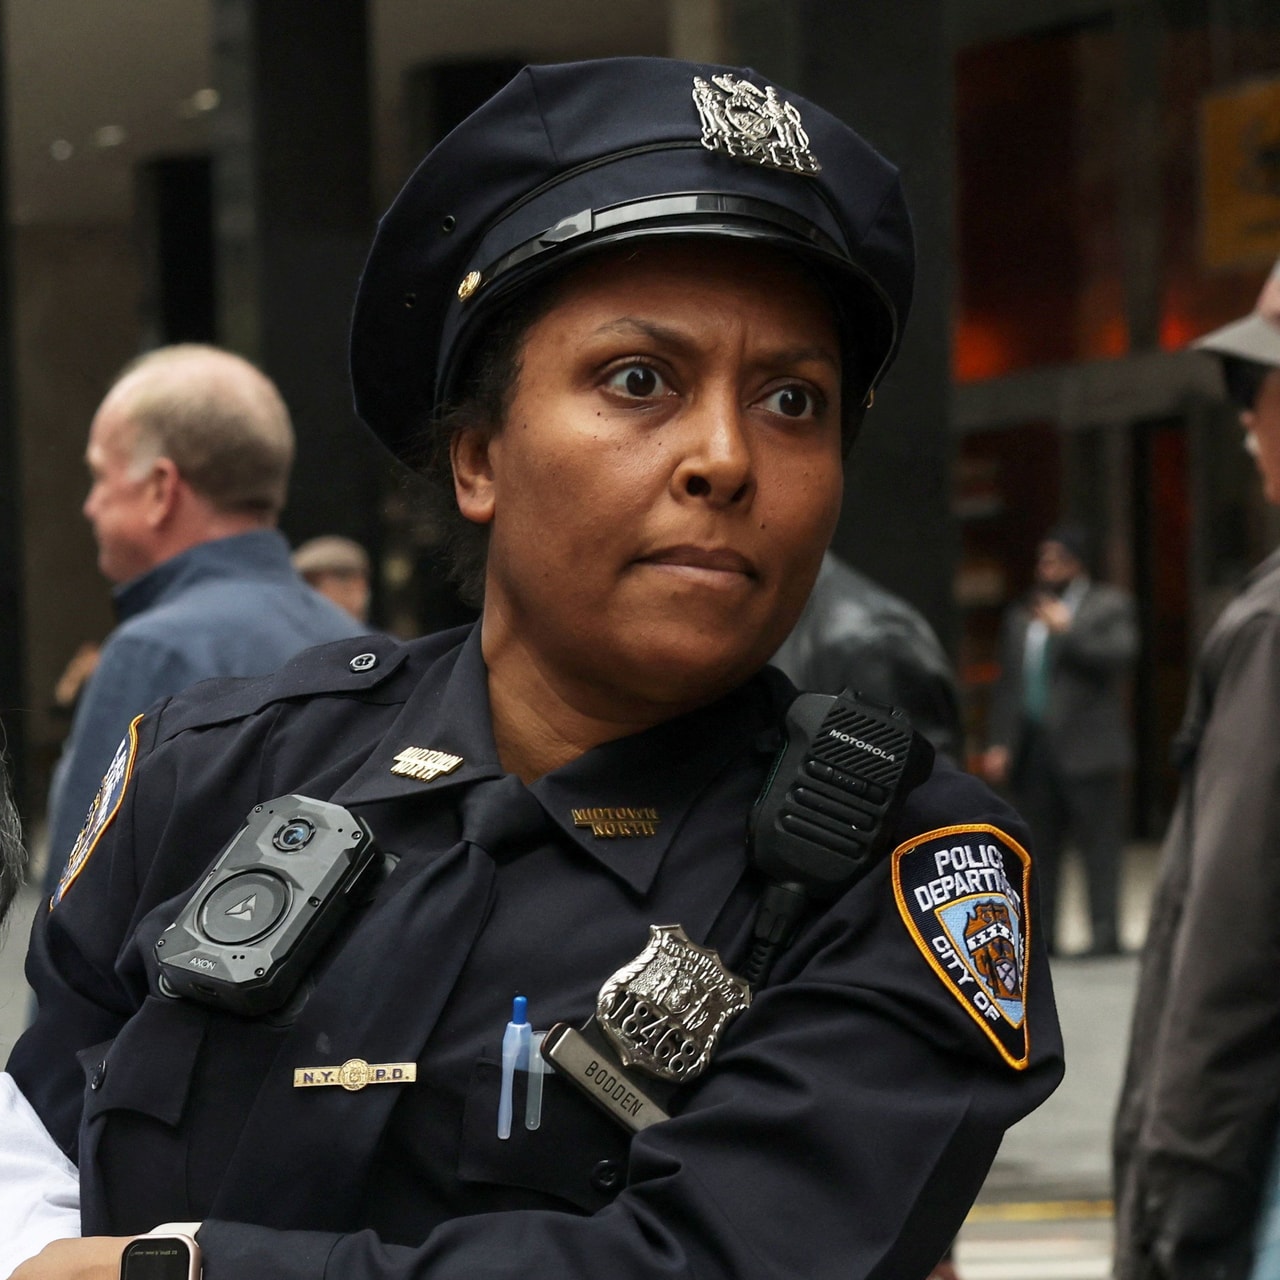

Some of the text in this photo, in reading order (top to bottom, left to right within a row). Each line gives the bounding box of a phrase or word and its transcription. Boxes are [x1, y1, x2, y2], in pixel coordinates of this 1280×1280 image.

[393, 746, 464, 773] MIDTOWN
[829, 729, 895, 762] MOTOROLA
[390, 760, 441, 783] NORTH
[571, 807, 660, 822] MIDTOWN
[591, 821, 655, 837] NORTH
[934, 845, 1005, 876] POLIC
[190, 957, 217, 971] AXON
[932, 936, 1000, 1021] CITY OF
[610, 992, 696, 1073] 18468
[584, 1060, 643, 1117] BODDEN
